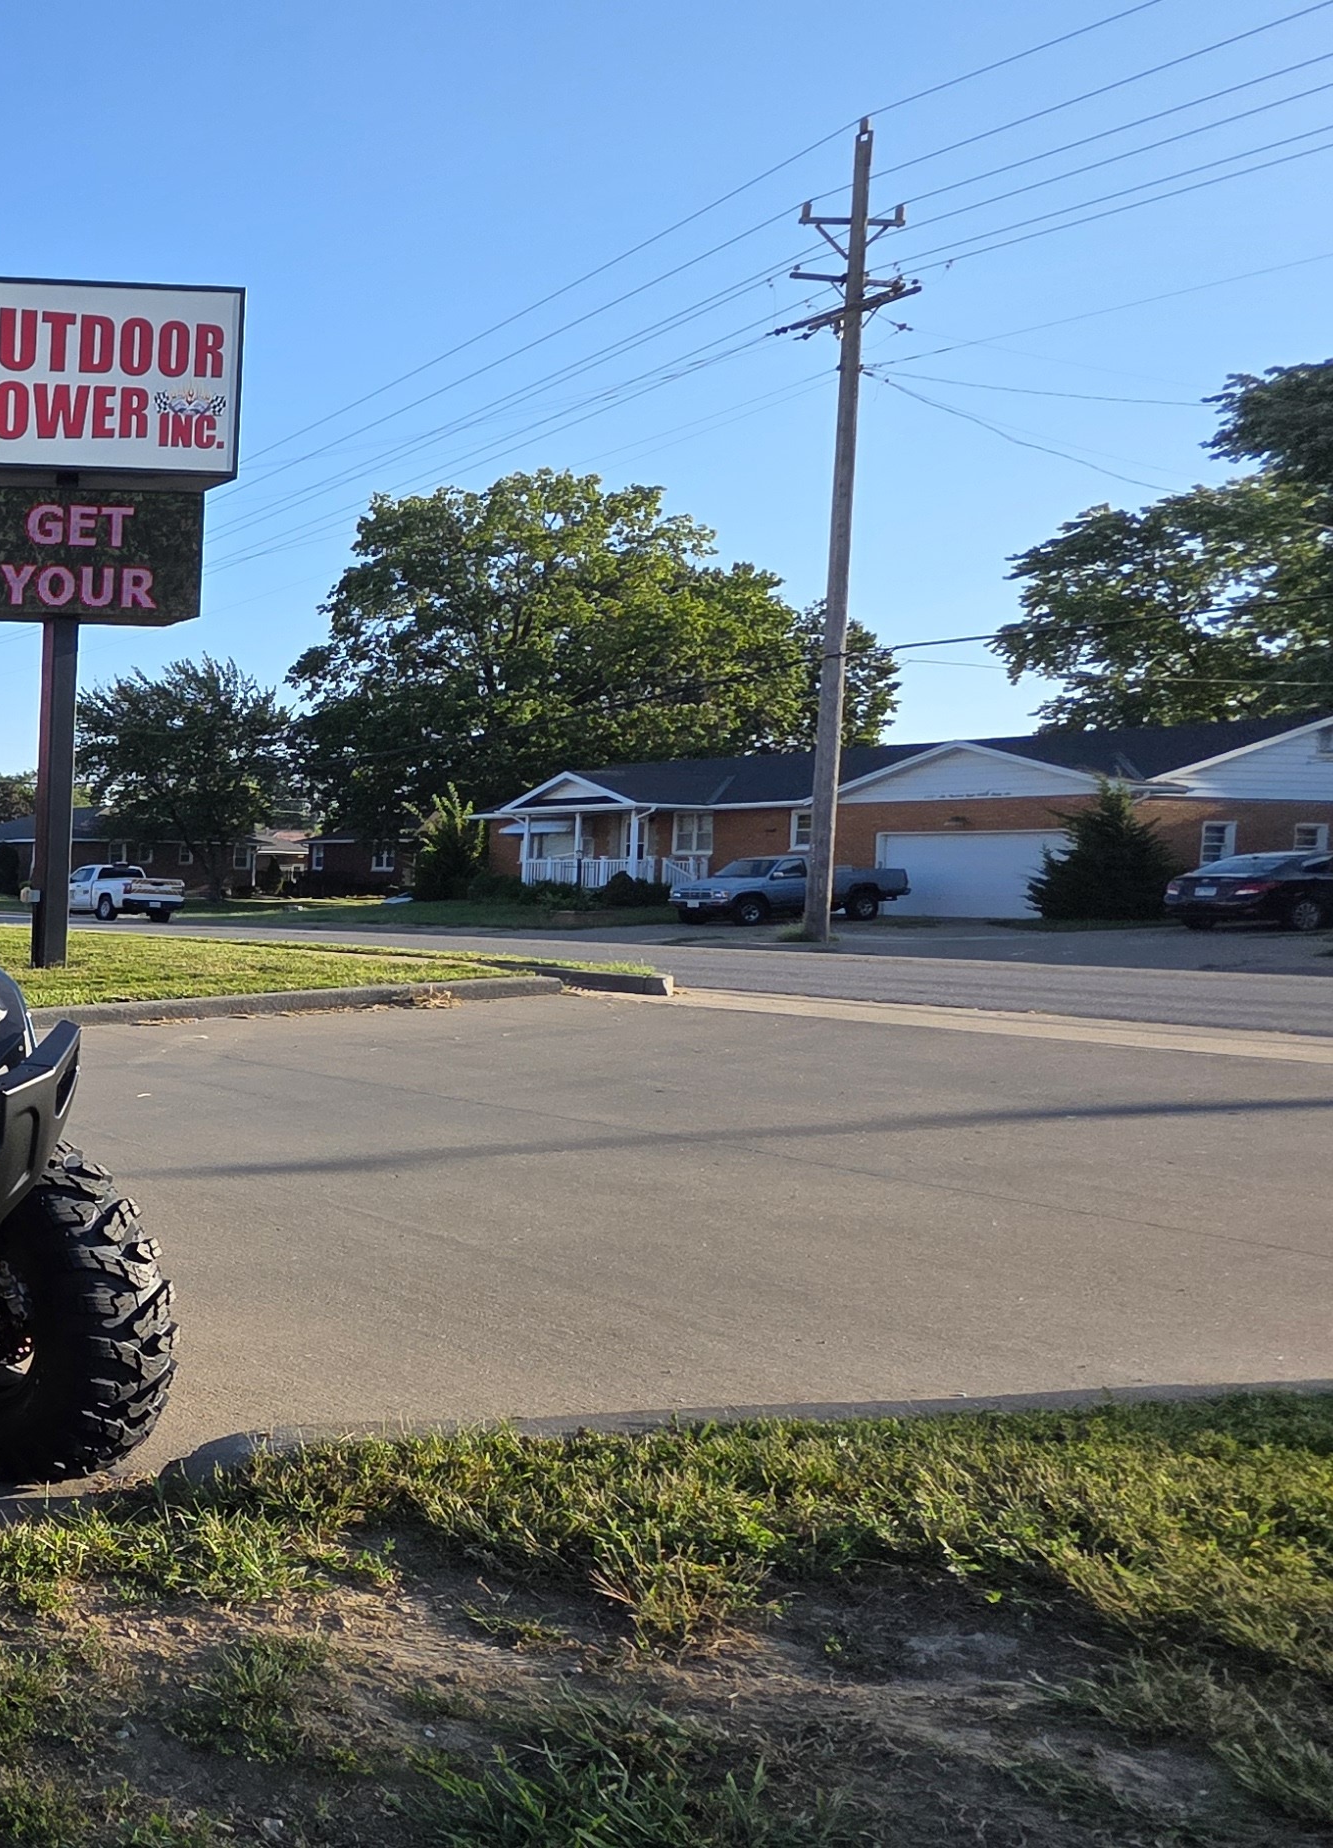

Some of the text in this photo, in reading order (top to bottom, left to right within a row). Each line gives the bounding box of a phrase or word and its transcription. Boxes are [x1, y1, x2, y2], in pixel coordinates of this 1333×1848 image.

[158, 412, 225, 449] INC.
[26, 504, 135, 547] GET
[0, 563, 157, 609] YOUR
